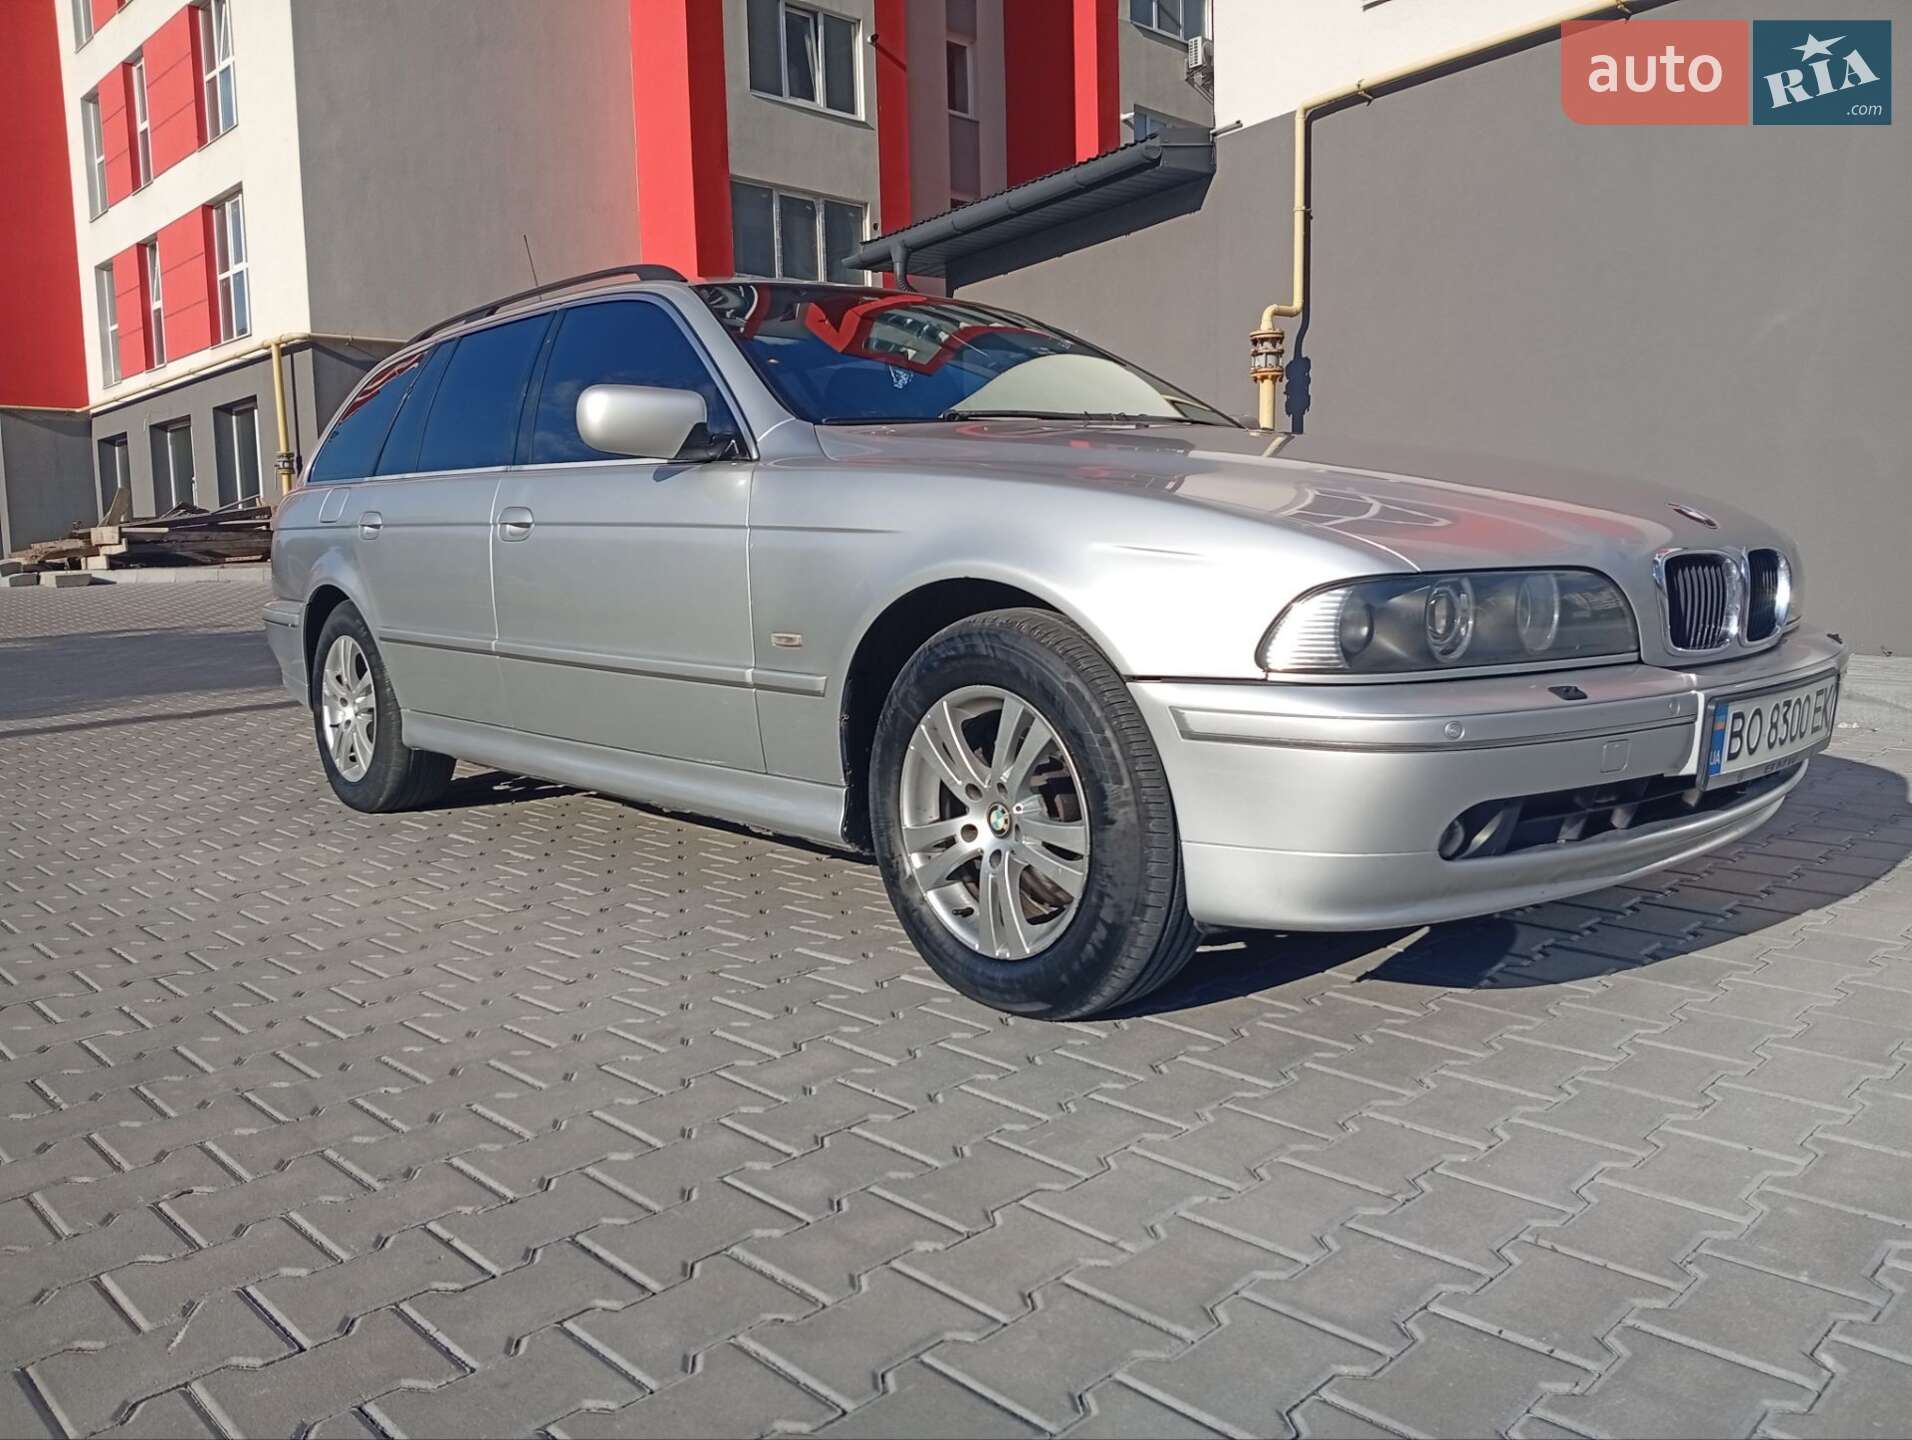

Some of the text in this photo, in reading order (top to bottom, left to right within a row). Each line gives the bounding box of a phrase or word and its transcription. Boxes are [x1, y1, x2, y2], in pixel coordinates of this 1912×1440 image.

[1726, 707, 1763, 761] BO
[1767, 694, 1811, 750] 8300
[1709, 750, 1721, 766] UA
